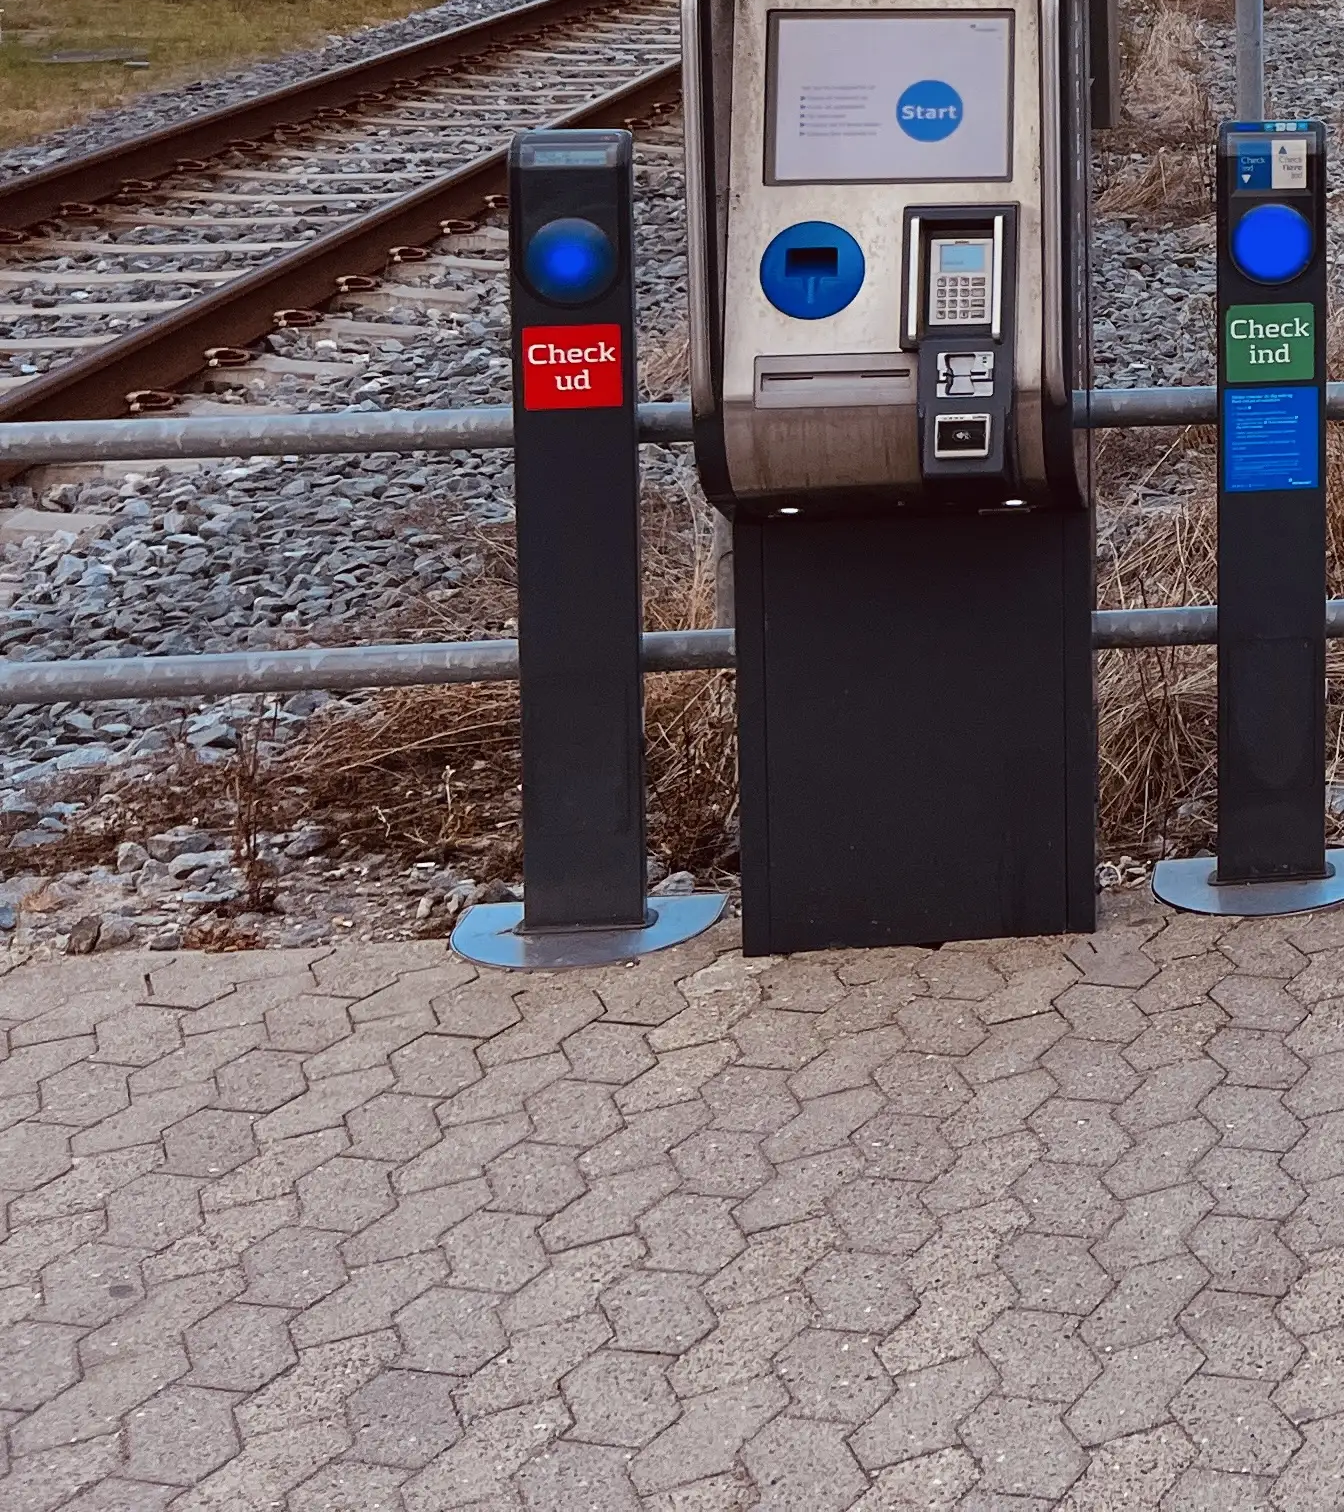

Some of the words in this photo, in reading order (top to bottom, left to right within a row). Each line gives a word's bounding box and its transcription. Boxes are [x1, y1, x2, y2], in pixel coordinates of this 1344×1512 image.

[901, 104, 958, 120] Start
[1240, 156, 1265, 164] Check
[1230, 317, 1311, 340] Check
[527, 341, 616, 365] Check
[1249, 344, 1290, 365] ind
[555, 369, 591, 391] ud
